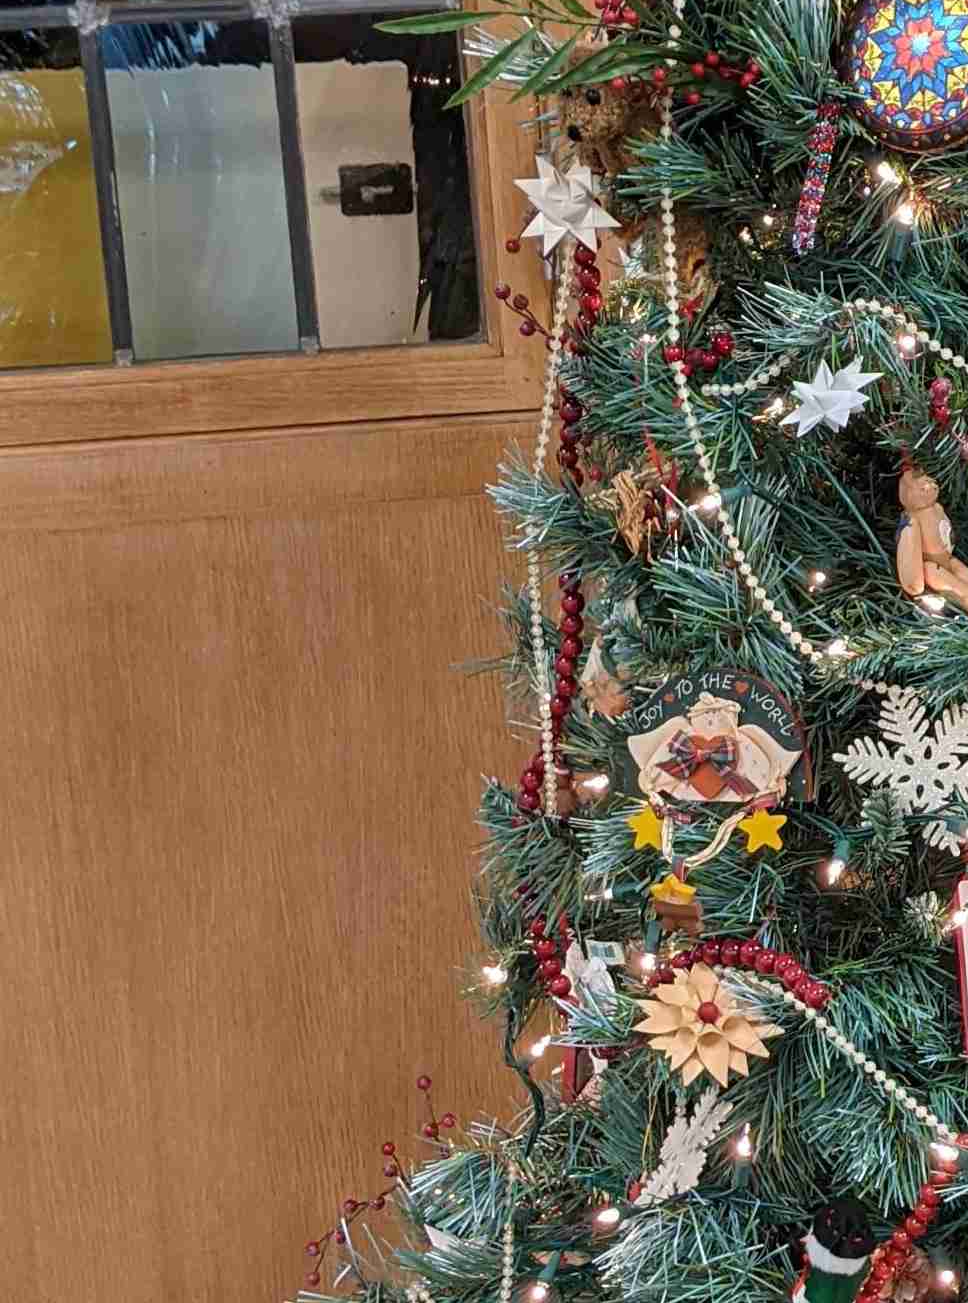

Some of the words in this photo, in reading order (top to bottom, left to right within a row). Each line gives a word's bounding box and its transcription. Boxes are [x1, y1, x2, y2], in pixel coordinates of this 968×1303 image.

[638, 699, 663, 729] JOY
[674, 678, 694, 699] TO
[699, 672, 735, 690] THE
